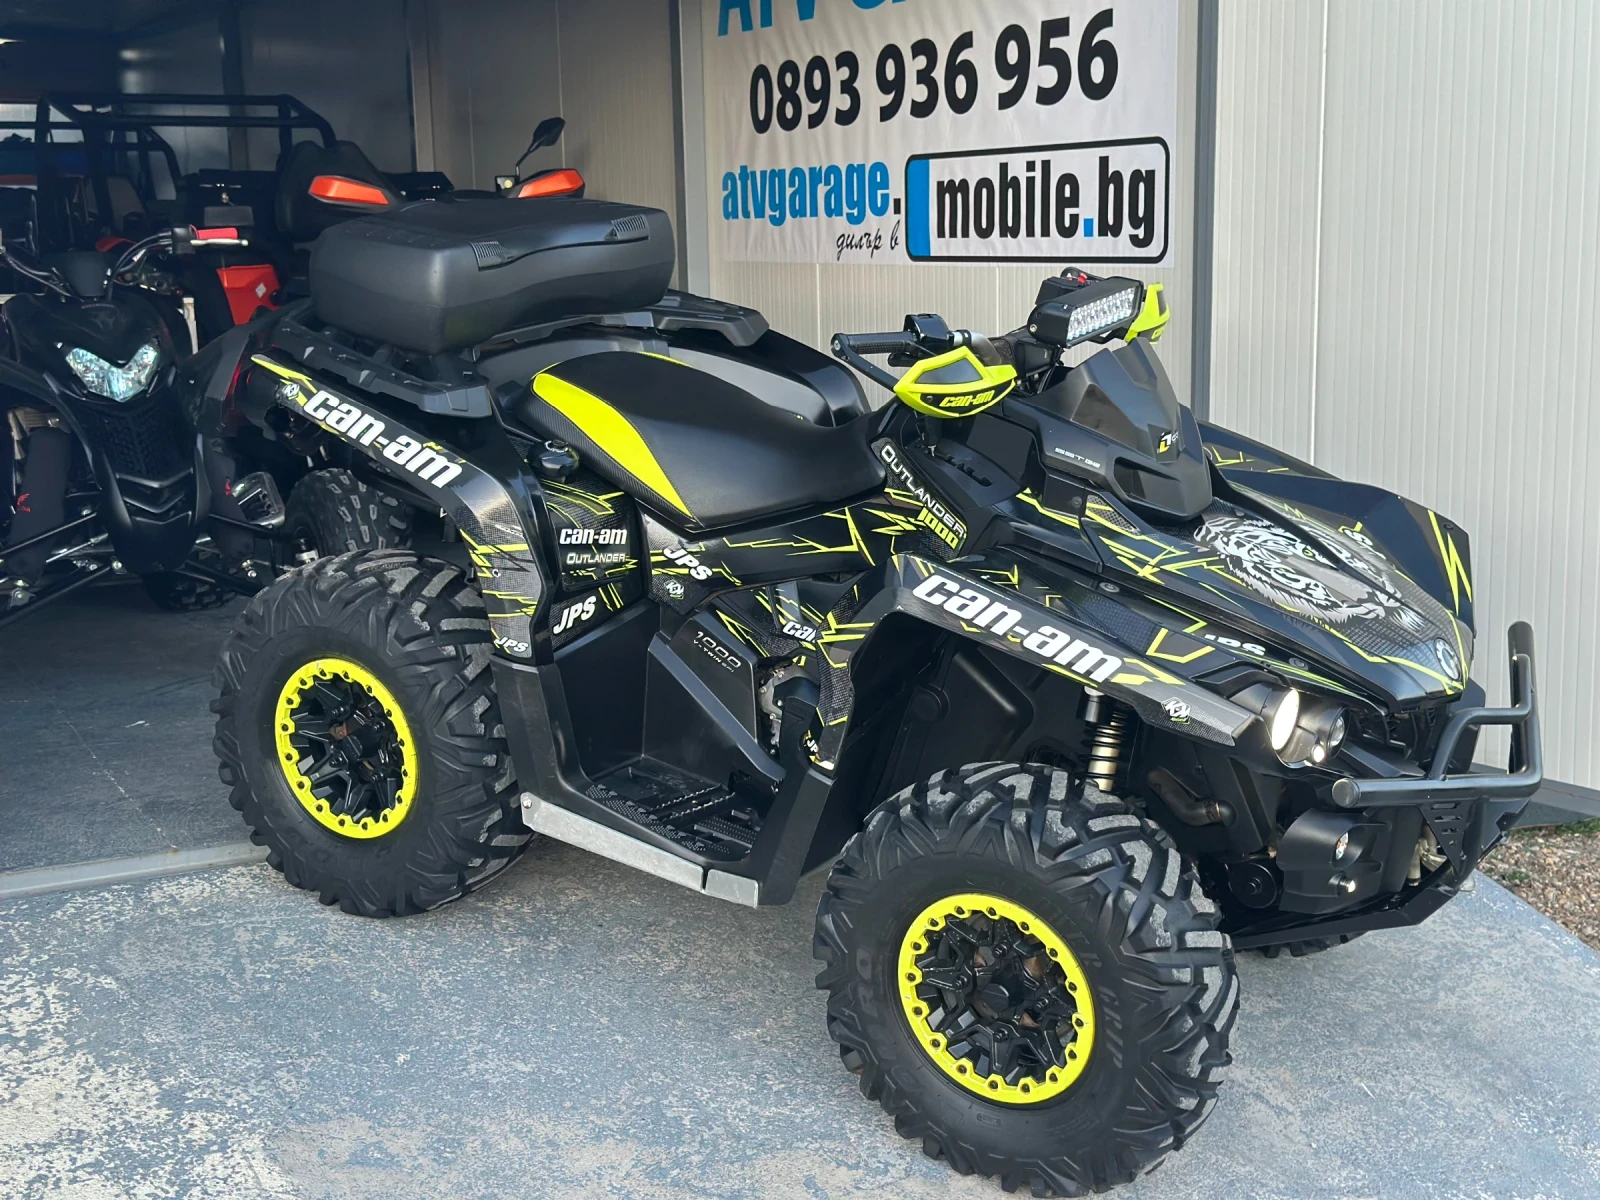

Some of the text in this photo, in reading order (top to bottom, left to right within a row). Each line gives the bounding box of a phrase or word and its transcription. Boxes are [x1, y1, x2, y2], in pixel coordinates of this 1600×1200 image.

[750, 8, 1119, 135] 0893 936 956
[936, 155, 1157, 249] mobile.bg
[938, 389, 996, 408] can-am
[303, 389, 463, 489] can-am
[881, 444, 965, 538] OUTLANDER
[559, 527, 628, 546] can-am
[565, 551, 626, 565] OUTLANDER
[662, 547, 713, 580] JPS
[552, 595, 597, 635] JPS
[912, 573, 1123, 684] can-am
[495, 635, 529, 653] JPS
